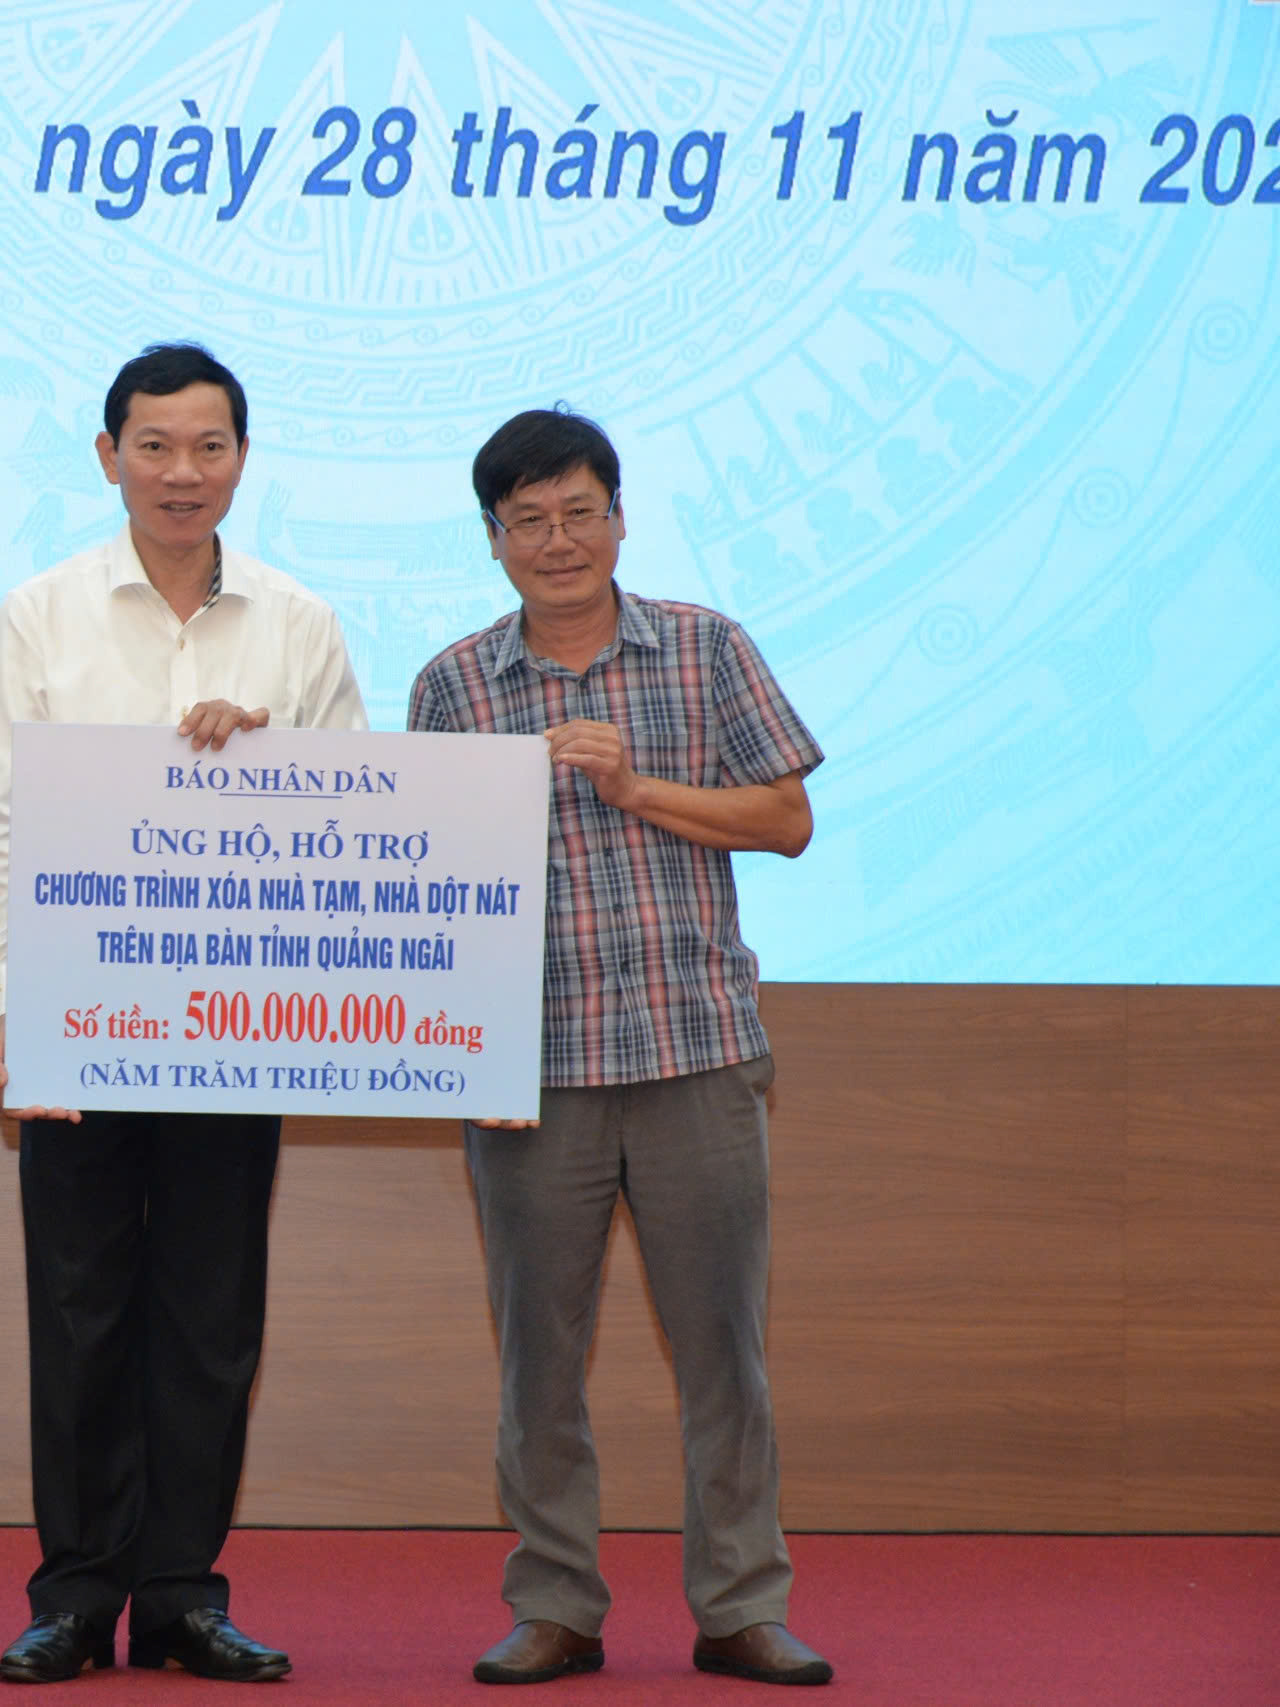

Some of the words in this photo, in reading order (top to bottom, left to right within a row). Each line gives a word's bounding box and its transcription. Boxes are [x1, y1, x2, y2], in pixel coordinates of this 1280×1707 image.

[34, 99, 277, 222] ngày
[301, 106, 417, 199] 28
[451, 103, 727, 226] tháng
[770, 111, 863, 201] 11
[901, 109, 1107, 204] năm
[166, 760, 230, 790] BÁO
[238, 762, 325, 792] NHÂN
[333, 764, 397, 793] DÂN
[131, 819, 207, 856] ỦNG
[217, 822, 281, 865] HỘ,
[290, 819, 344, 859] HỖ
[353, 830, 429, 868] TRỢ
[34, 870, 127, 908] CHƯƠNG
[133, 868, 200, 909] TRÌNH
[206, 870, 252, 910] XÓA
[258, 872, 306, 912] NHÀ
[312, 879, 367, 920] TẠM,
[373, 874, 421, 914] NHÀ
[426, 875, 470, 922] DỘT
[475, 876, 521, 916] NÁT
[96, 924, 155, 965] TRÊN
[160, 932, 199, 973] ĐỊA
[205, 927, 253, 967] BÀN
[258, 923, 311, 968] TỈNH
[316, 925, 394, 973] QUẢNG
[399, 931, 455, 971] NGÃI
[64, 1003, 103, 1039] Số
[107, 1003, 169, 1041] tiền:
[183, 990, 406, 1045] 500.000.000
[413, 1009, 484, 1054] đồng
[79, 1057, 161, 1089] (NĂM
[167, 1059, 259, 1089] TRĂM
[266, 1060, 361, 1097] TRIỆU
[367, 1057, 466, 1097] ĐỒNG)
